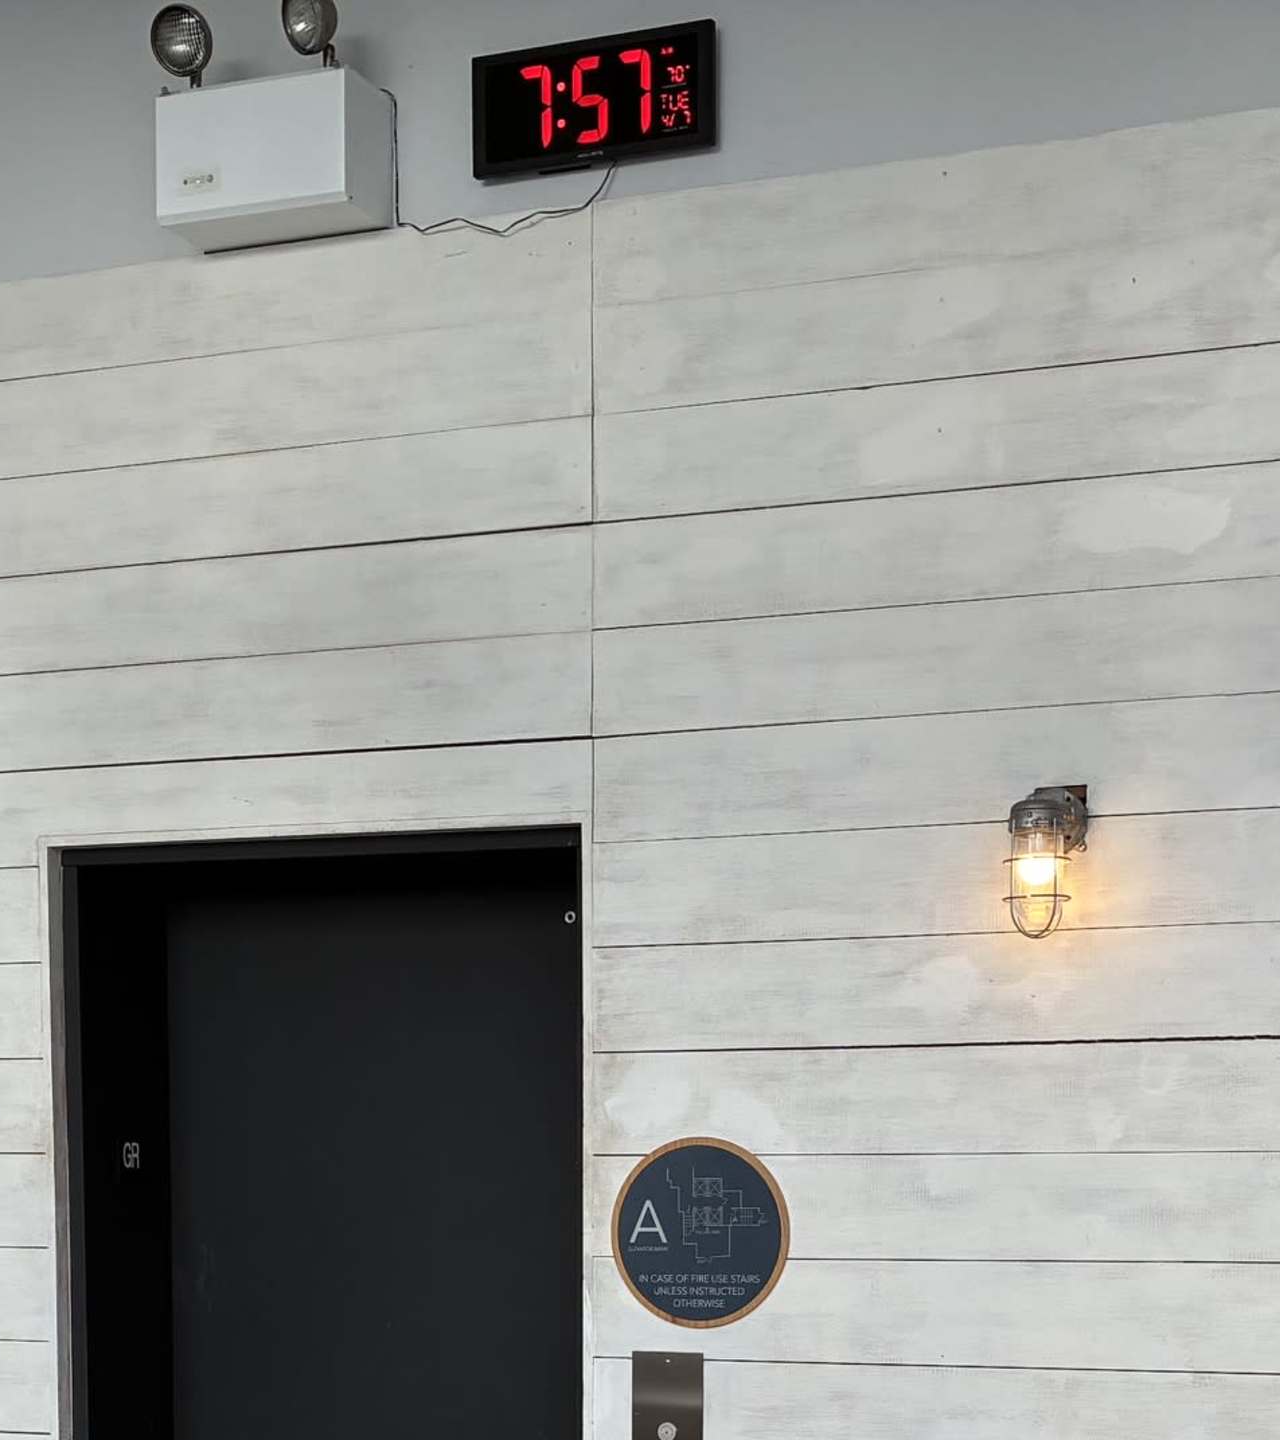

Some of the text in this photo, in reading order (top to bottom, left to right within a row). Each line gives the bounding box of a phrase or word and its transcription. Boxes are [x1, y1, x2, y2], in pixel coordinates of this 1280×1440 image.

[519, 48, 652, 149] 7:57
[660, 90, 689, 111] TUE
[122, 1141, 140, 1169] GR
[629, 1199, 668, 1244] A
[639, 1273, 649, 1283] IN
[650, 1273, 674, 1283] CASE
[675, 1273, 689, 1283] OF
[673, 1299, 725, 1308] OTHERWISE
